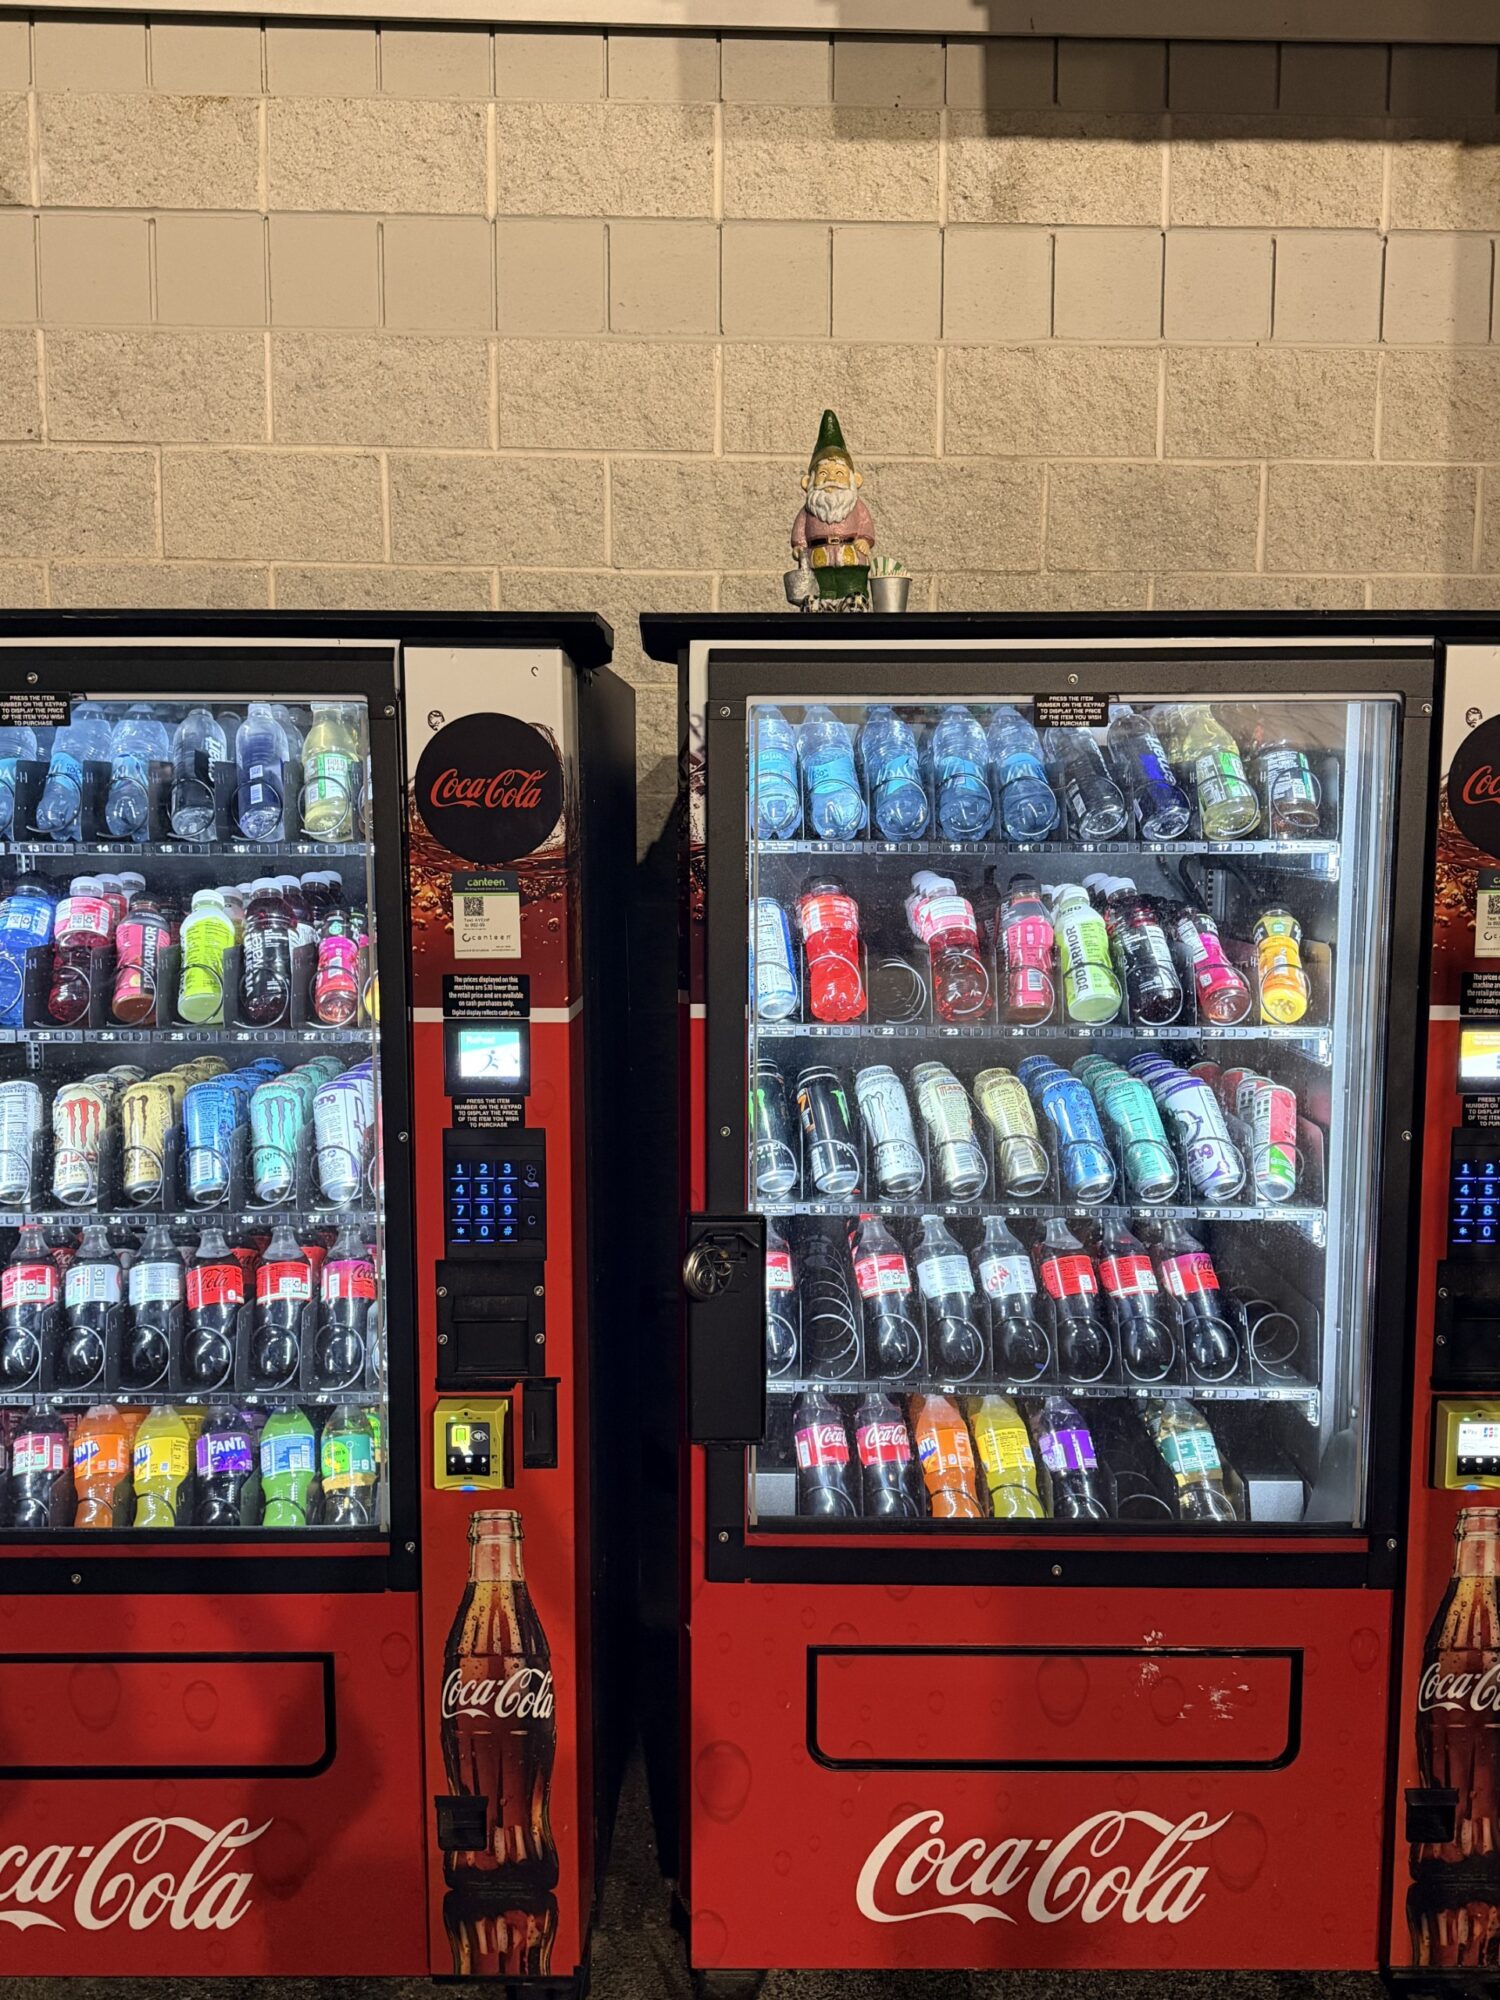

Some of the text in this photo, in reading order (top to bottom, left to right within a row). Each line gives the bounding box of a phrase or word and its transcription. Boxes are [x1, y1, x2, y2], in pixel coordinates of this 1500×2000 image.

[430, 768, 550, 808] Coca-Cola
[467, 878, 505, 886] canteen
[456, 1164, 511, 1173] 1 2 3
[1461, 1164, 1494, 1174] 1 2
[456, 1184, 512, 1194] 4 5 6
[1460, 1185, 1493, 1194] 4 5
[456, 1205, 512, 1215] 7 8 9
[1460, 1206, 1492, 1215] 7 8
[528, 1216, 536, 1225] C
[480, 1226, 488, 1236] 0
[1483, 1227, 1490, 1236] 0
[210, 1437, 246, 1454] FANTA
[1418, 1663, 1500, 1712] Coca-C
[442, 1668, 555, 1719] Coca-Cola
[856, 1810, 1233, 1925] Coca-Cola
[0, 1817, 274, 1932] ca-Cola
